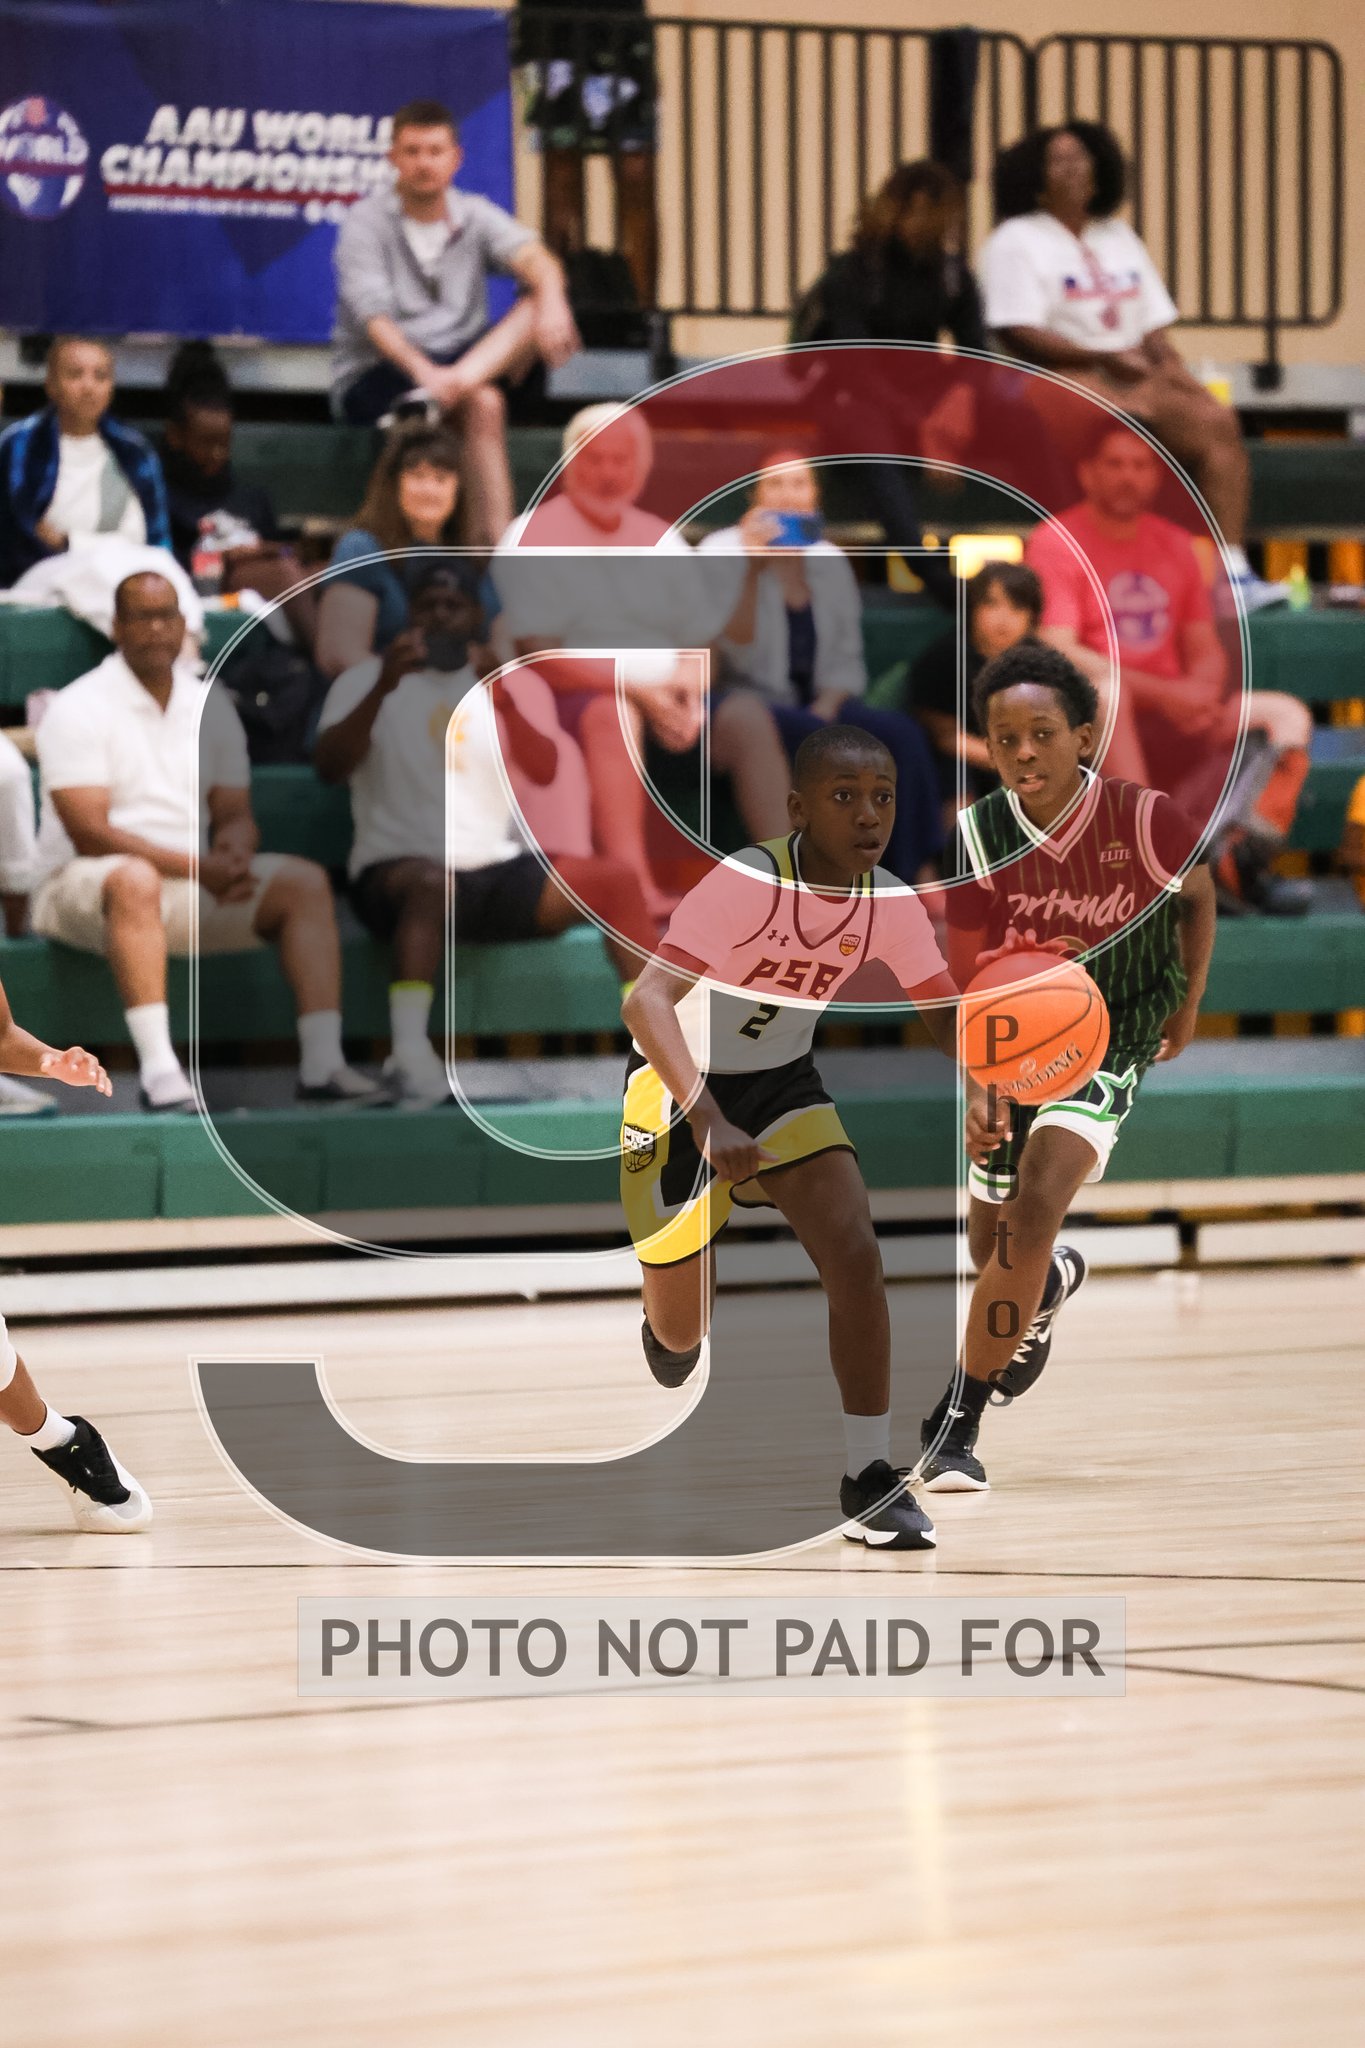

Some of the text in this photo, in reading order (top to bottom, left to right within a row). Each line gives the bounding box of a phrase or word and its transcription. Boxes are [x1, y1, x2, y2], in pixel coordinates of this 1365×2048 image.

[146, 105, 246, 147] AAU
[1100, 848, 1132, 863] ELITE
[739, 957, 844, 1001] PSB
[737, 1001, 782, 1041] 2
